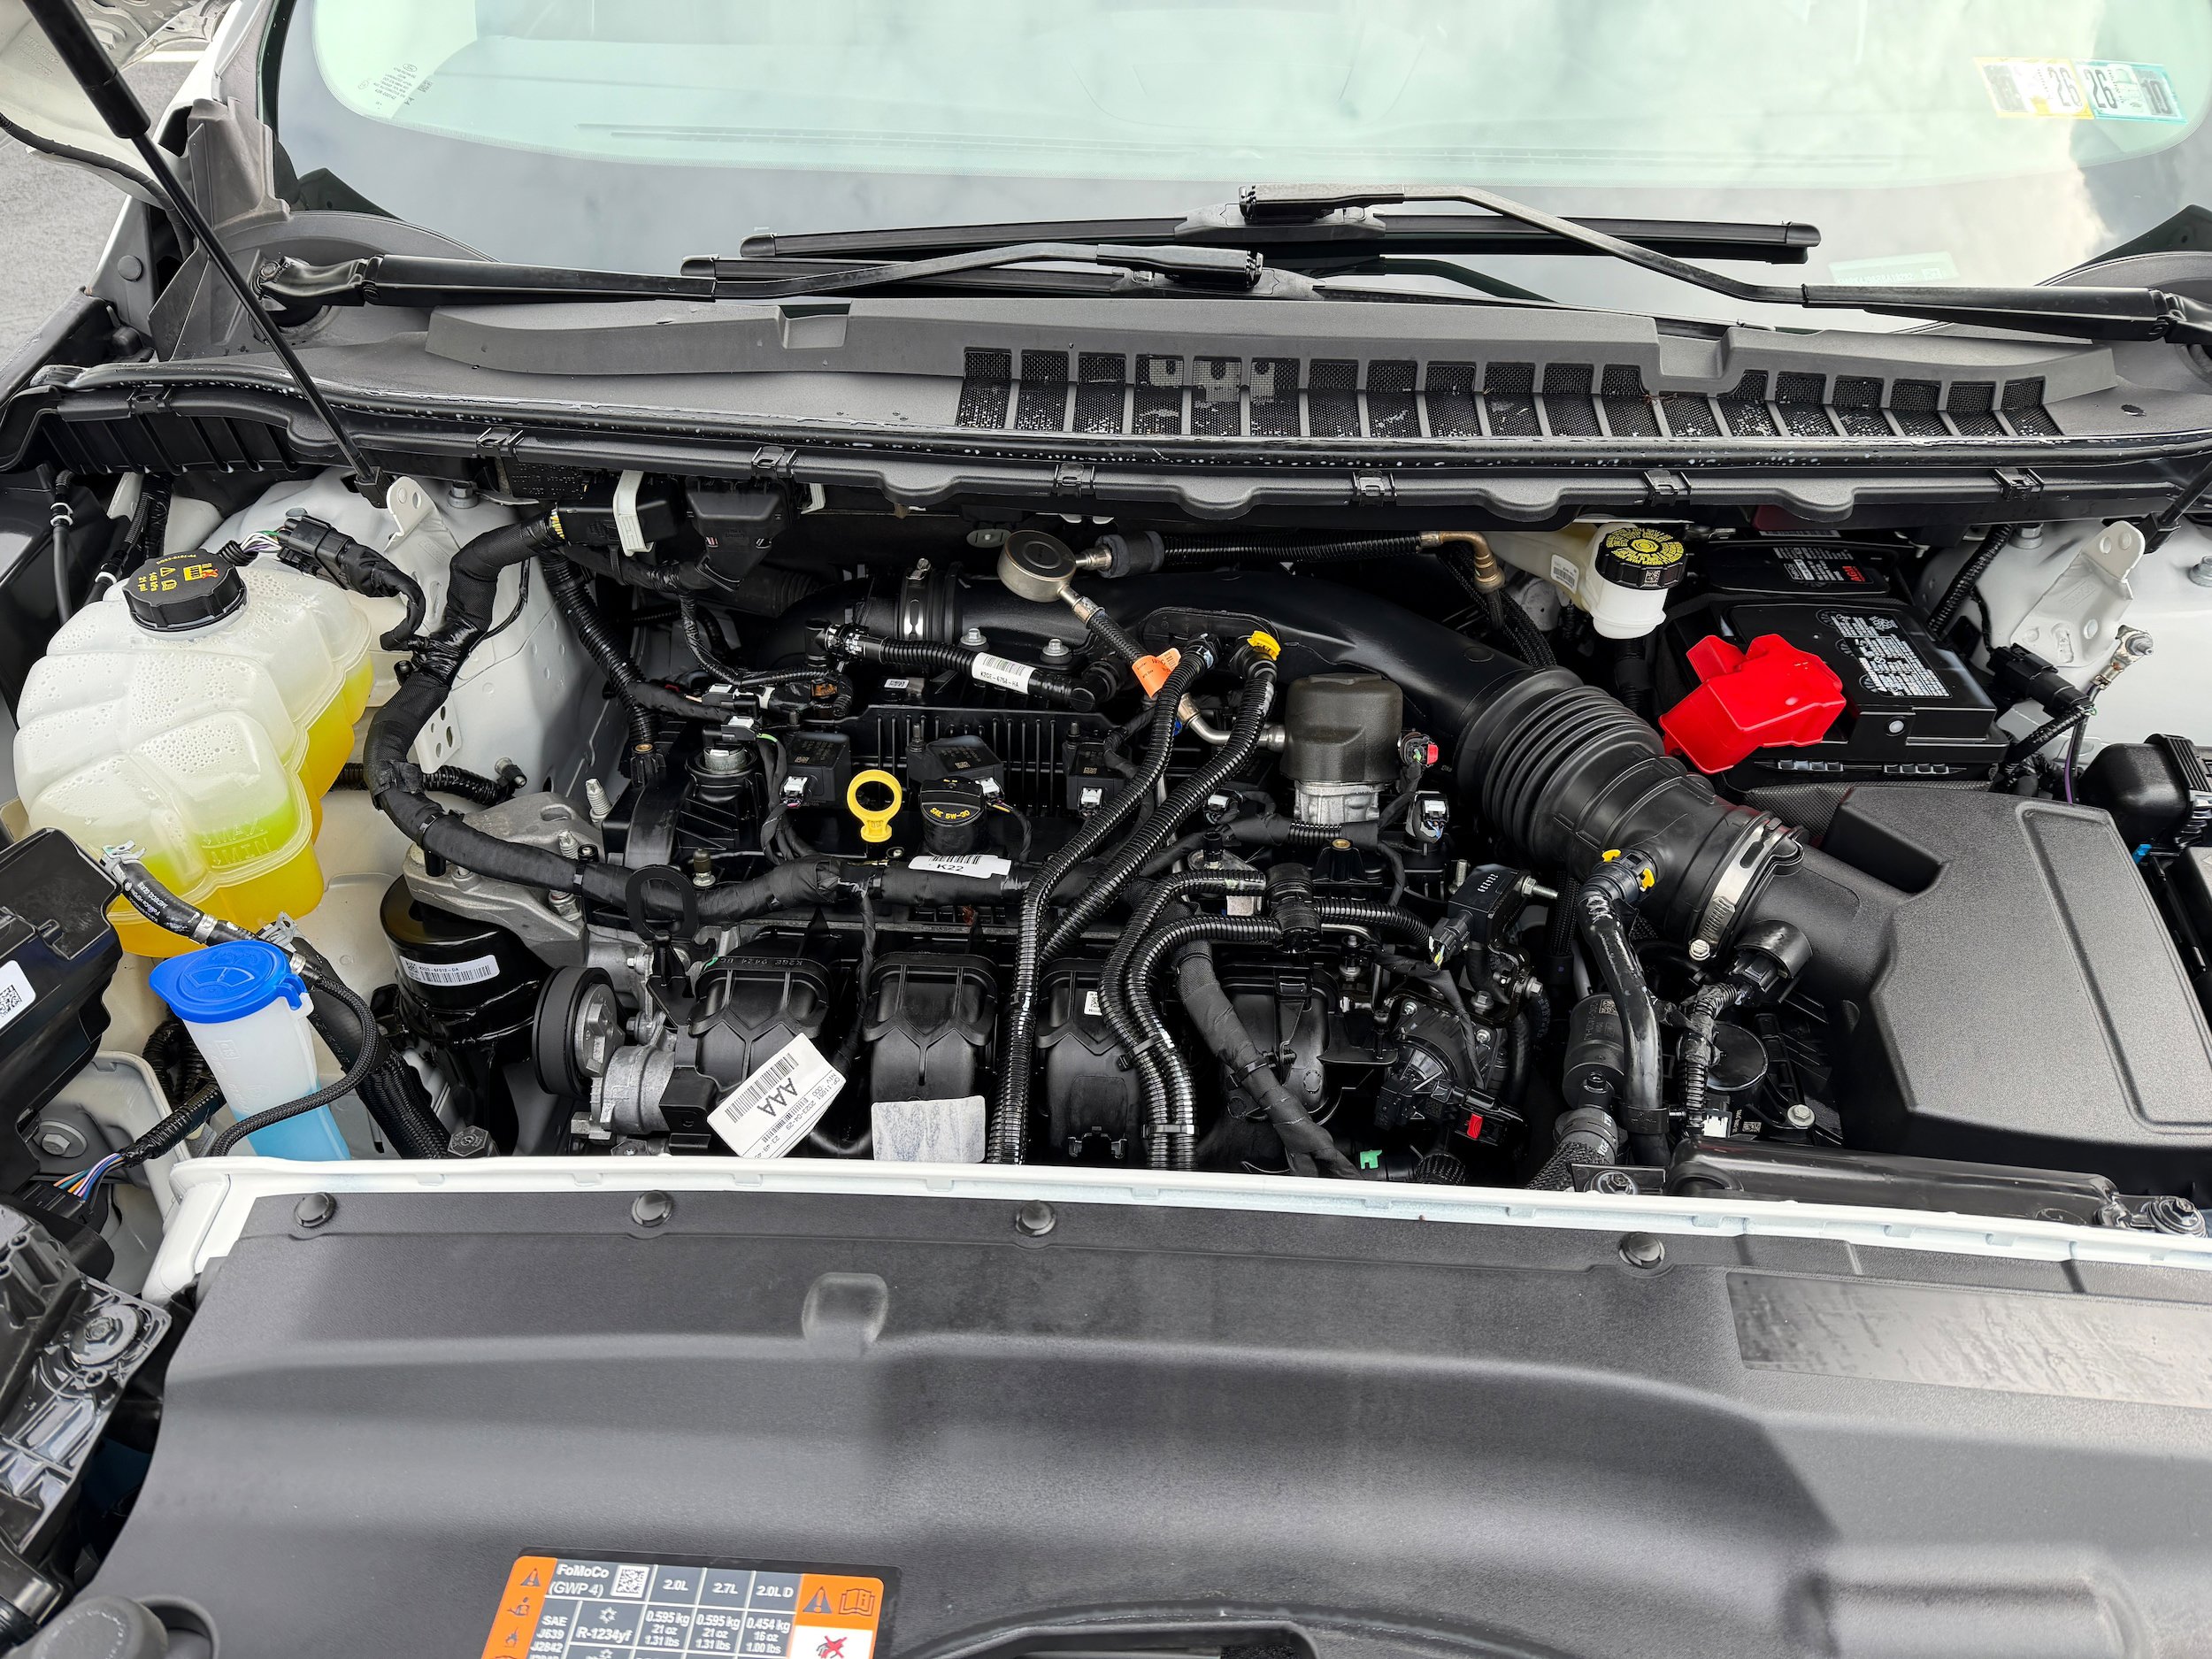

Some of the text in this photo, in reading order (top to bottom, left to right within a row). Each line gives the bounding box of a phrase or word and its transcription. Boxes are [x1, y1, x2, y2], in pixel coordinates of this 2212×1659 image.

[2047, 66, 2083, 107] 26
[2083, 69, 2118, 109] 26
[1842, 565, 1862, 581] AGM
[930, 807, 971, 819] SAE 5W-30
[222, 837, 272, 864] MIN
[936, 864, 964, 872] K22
[757, 1077, 798, 1117] AAA
[556, 1563, 610, 1579] FoMoCo
[548, 1580, 604, 1598] (GWP 4)
[663, 1579, 688, 1592] 2.0L
[711, 1582, 738, 1594] 2.7L
[756, 1586, 794, 1598] 2.0L D
[541, 1615, 569, 1627] SAE
[645, 1610, 691, 1627] 0.595 kg
[695, 1614, 741, 1631] 0.595 kg
[651, 1624, 678, 1636] 21 oz
[746, 1617, 791, 1634] 0.454 kg
[536, 1629, 565, 1640] J639
[575, 1626, 634, 1644] R-1234yf
[702, 1627, 729, 1640] 21 oz
[754, 1631, 780, 1642] 16 oz
[530, 1641, 564, 1654] J2842
[644, 1635, 680, 1648] 1.31 lbs
[695, 1639, 732, 1651] 1.31 lbs
[746, 1642, 781, 1655] 1.00 lbs
